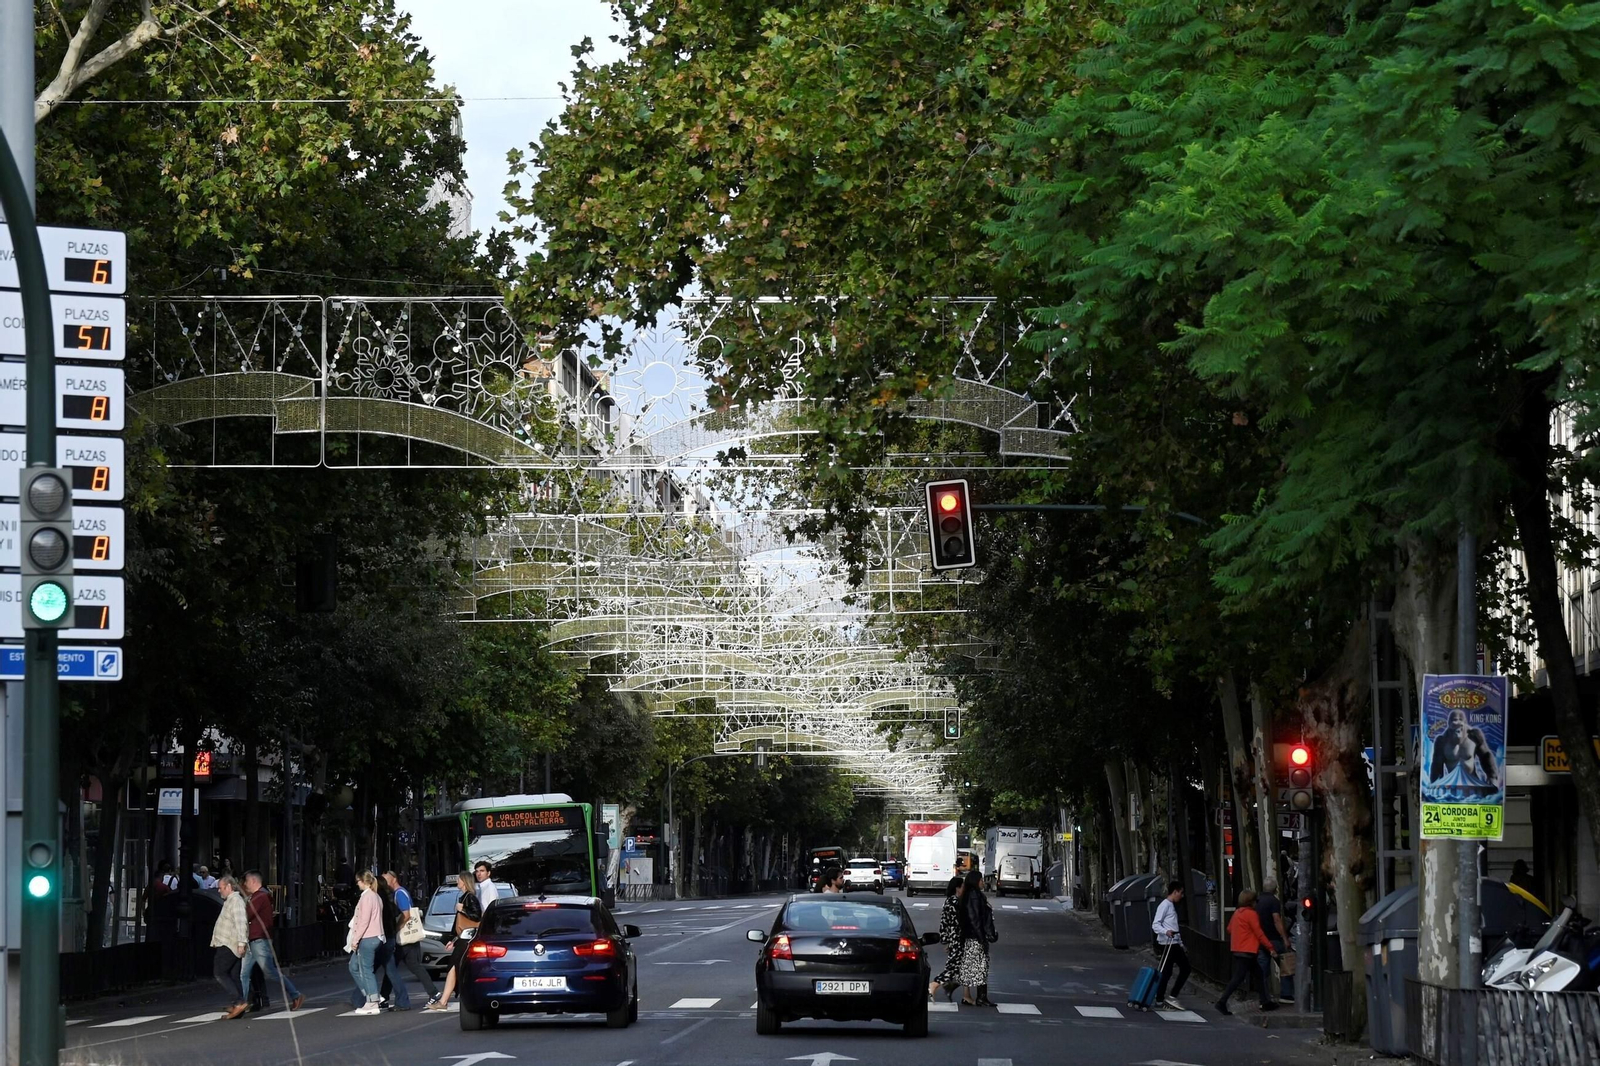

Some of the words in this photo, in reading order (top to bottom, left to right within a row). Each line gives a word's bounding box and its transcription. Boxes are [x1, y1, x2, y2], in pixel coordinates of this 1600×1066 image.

[67, 241, 108, 256] PLAZAS
[92, 259, 108, 285] 6
[65, 308, 109, 321] PLAZAS
[78, 325, 109, 351] 51
[66, 378, 107, 392] PLAZAS
[91, 396, 107, 421] 8
[65, 449, 107, 462] PLAZAS
[92, 466, 108, 491] 8
[92, 536, 108, 561] 8
[100, 606, 108, 630] 1
[1469, 713, 1484, 723] KING
[1485, 714, 1502, 724] KONG
[1547, 742, 1563, 754] ho
[1425, 811, 1440, 824] 24
[1441, 805, 1478, 817] CÓRDOBA
[485, 814, 494, 829] 8
[499, 810, 560, 821] VALDEOLLEROS
[1485, 813, 1494, 826] 9
[627, 838, 634, 851] P
[521, 979, 543, 988] 6164
[546, 979, 562, 988] JLR
[822, 982, 845, 991] 2921
[849, 982, 867, 991] DPY
